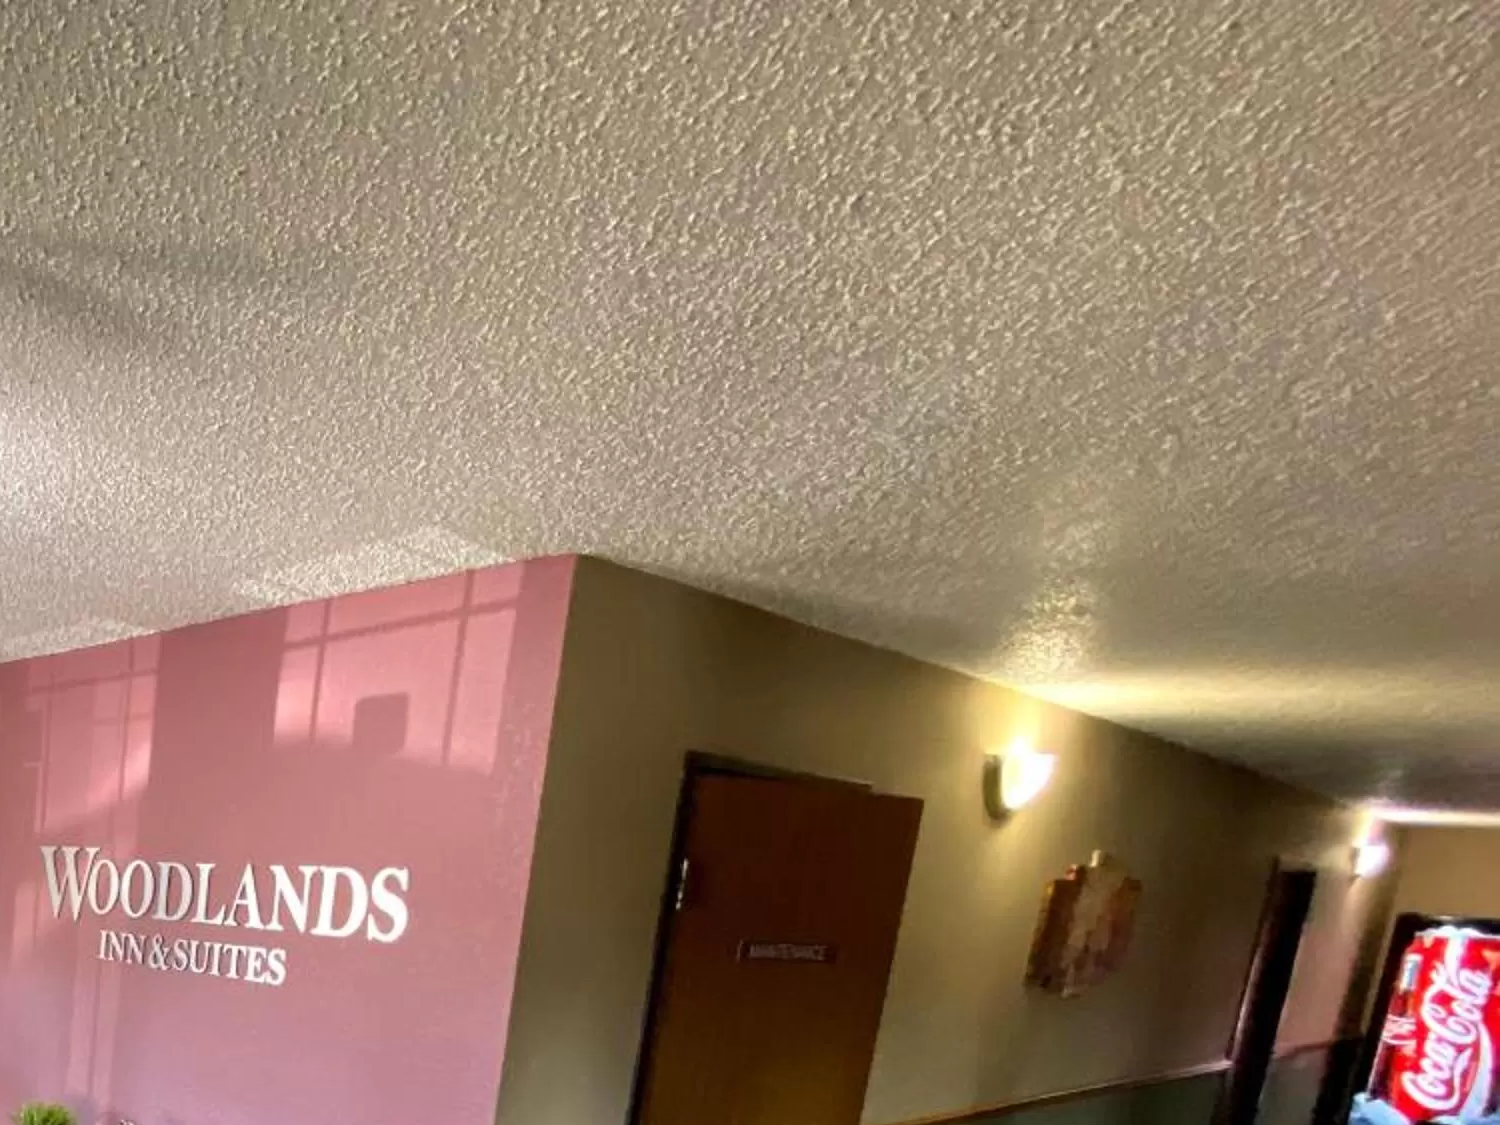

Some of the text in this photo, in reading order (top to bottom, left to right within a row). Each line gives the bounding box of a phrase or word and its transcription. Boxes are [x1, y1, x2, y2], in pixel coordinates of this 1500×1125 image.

[40, 845, 409, 942] WOODLANDS
[98, 929, 146, 965] INN
[172, 938, 287, 986] SUITES
